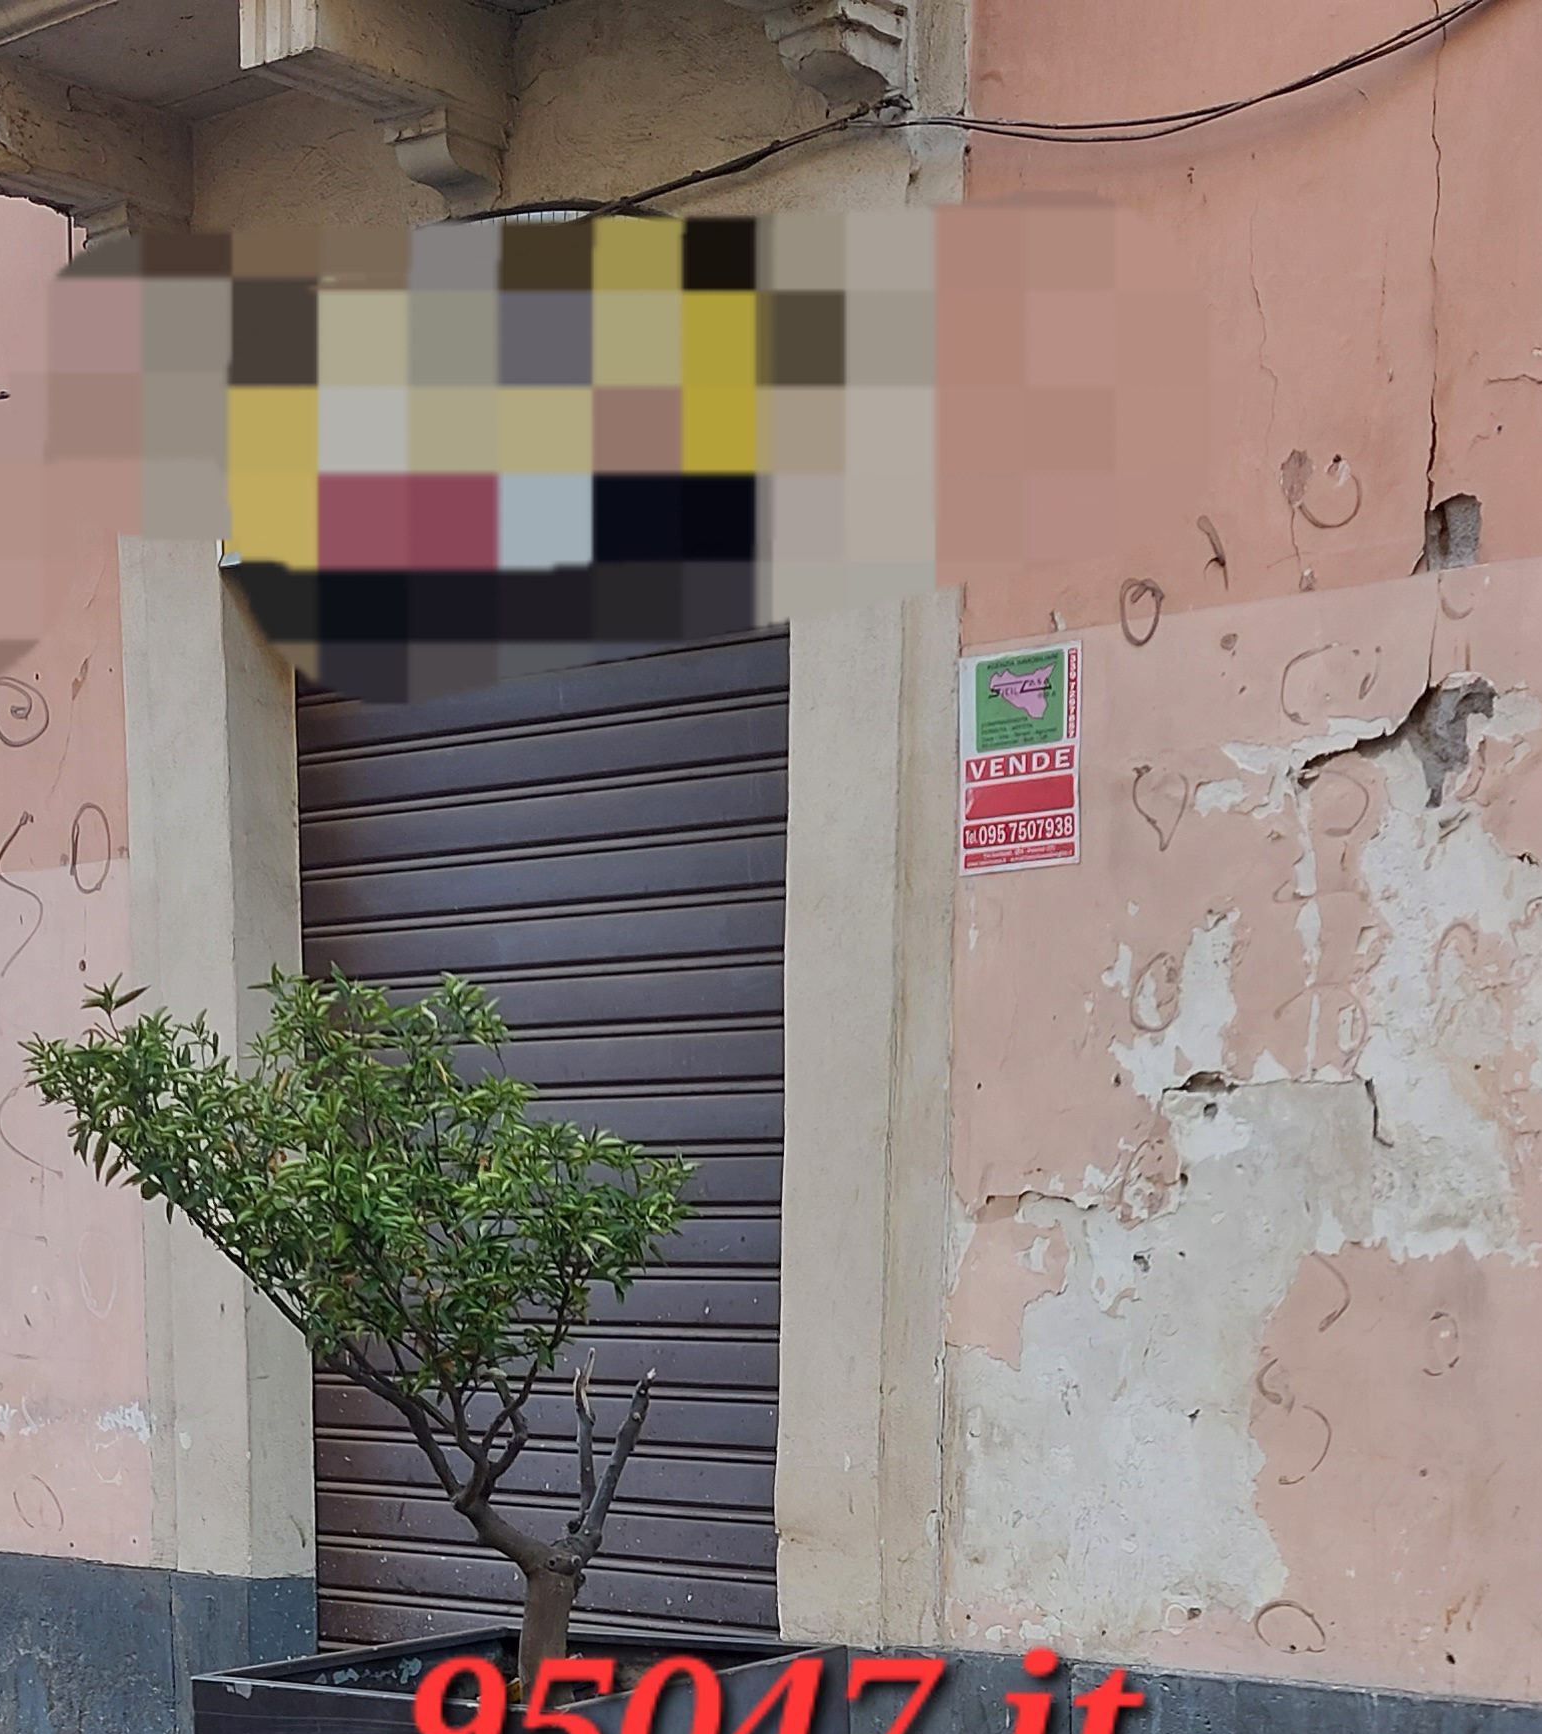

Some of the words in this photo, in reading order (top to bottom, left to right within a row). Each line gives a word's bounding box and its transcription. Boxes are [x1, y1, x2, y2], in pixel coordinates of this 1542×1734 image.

[970, 748, 1071, 780] VENDE
[979, 823, 1006, 845] 095
[1008, 815, 1073, 842] 7507938
